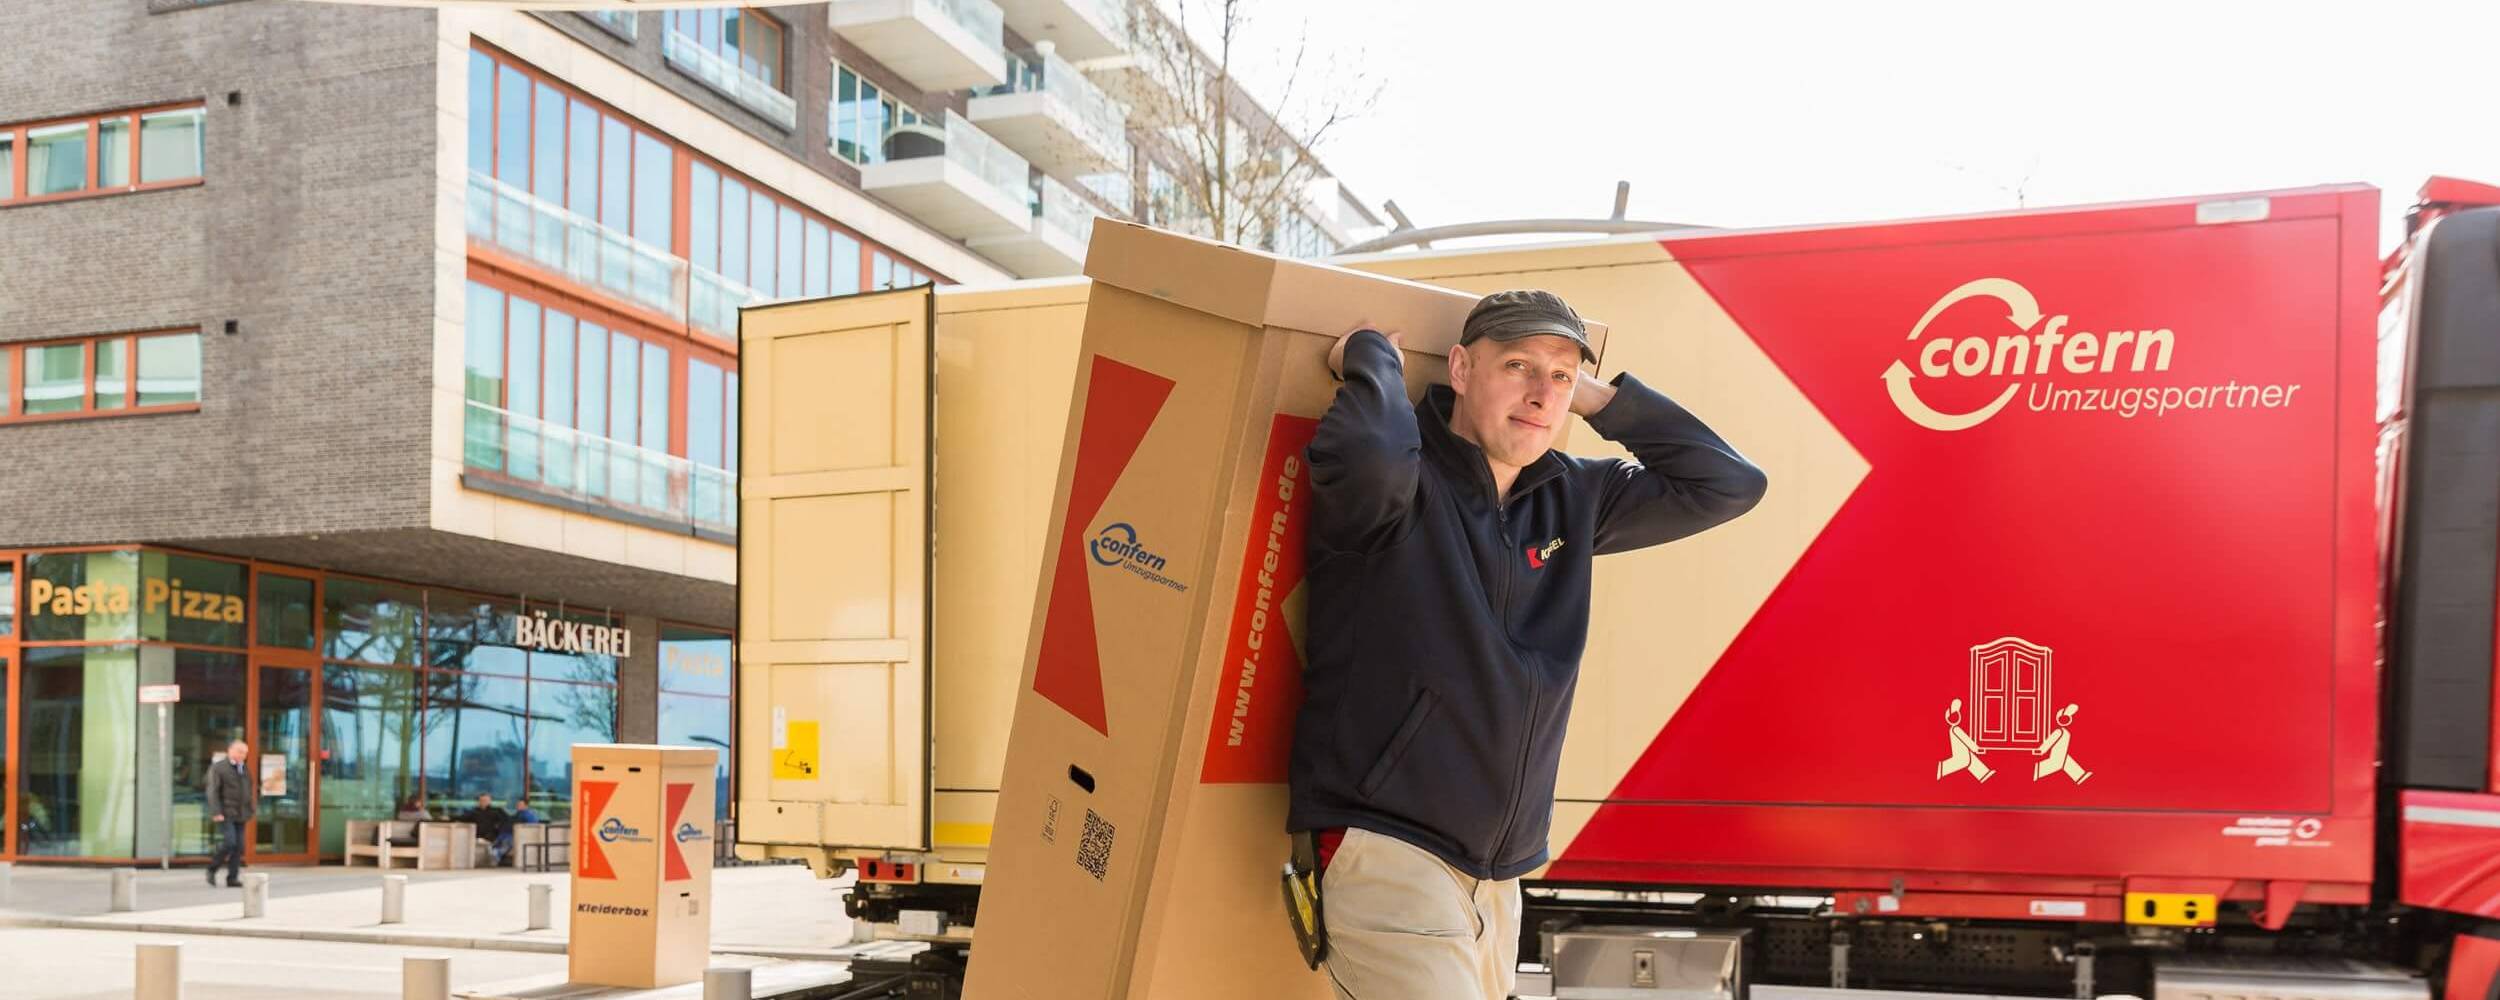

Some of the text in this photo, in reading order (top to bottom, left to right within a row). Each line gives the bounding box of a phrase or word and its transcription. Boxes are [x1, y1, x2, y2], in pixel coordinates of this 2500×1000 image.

[1919, 315, 2175, 378] confern
[2027, 380, 2302, 418] Umzugspartner
[1101, 536, 1167, 571] confern
[1122, 560, 1188, 592] Umzugspartner
[30, 577, 245, 623] Pasta Pizza
[1227, 455, 1301, 747] www.confern.de
[515, 609, 632, 657] BÄCKEREI
[577, 904, 649, 917] Kleiderbox
